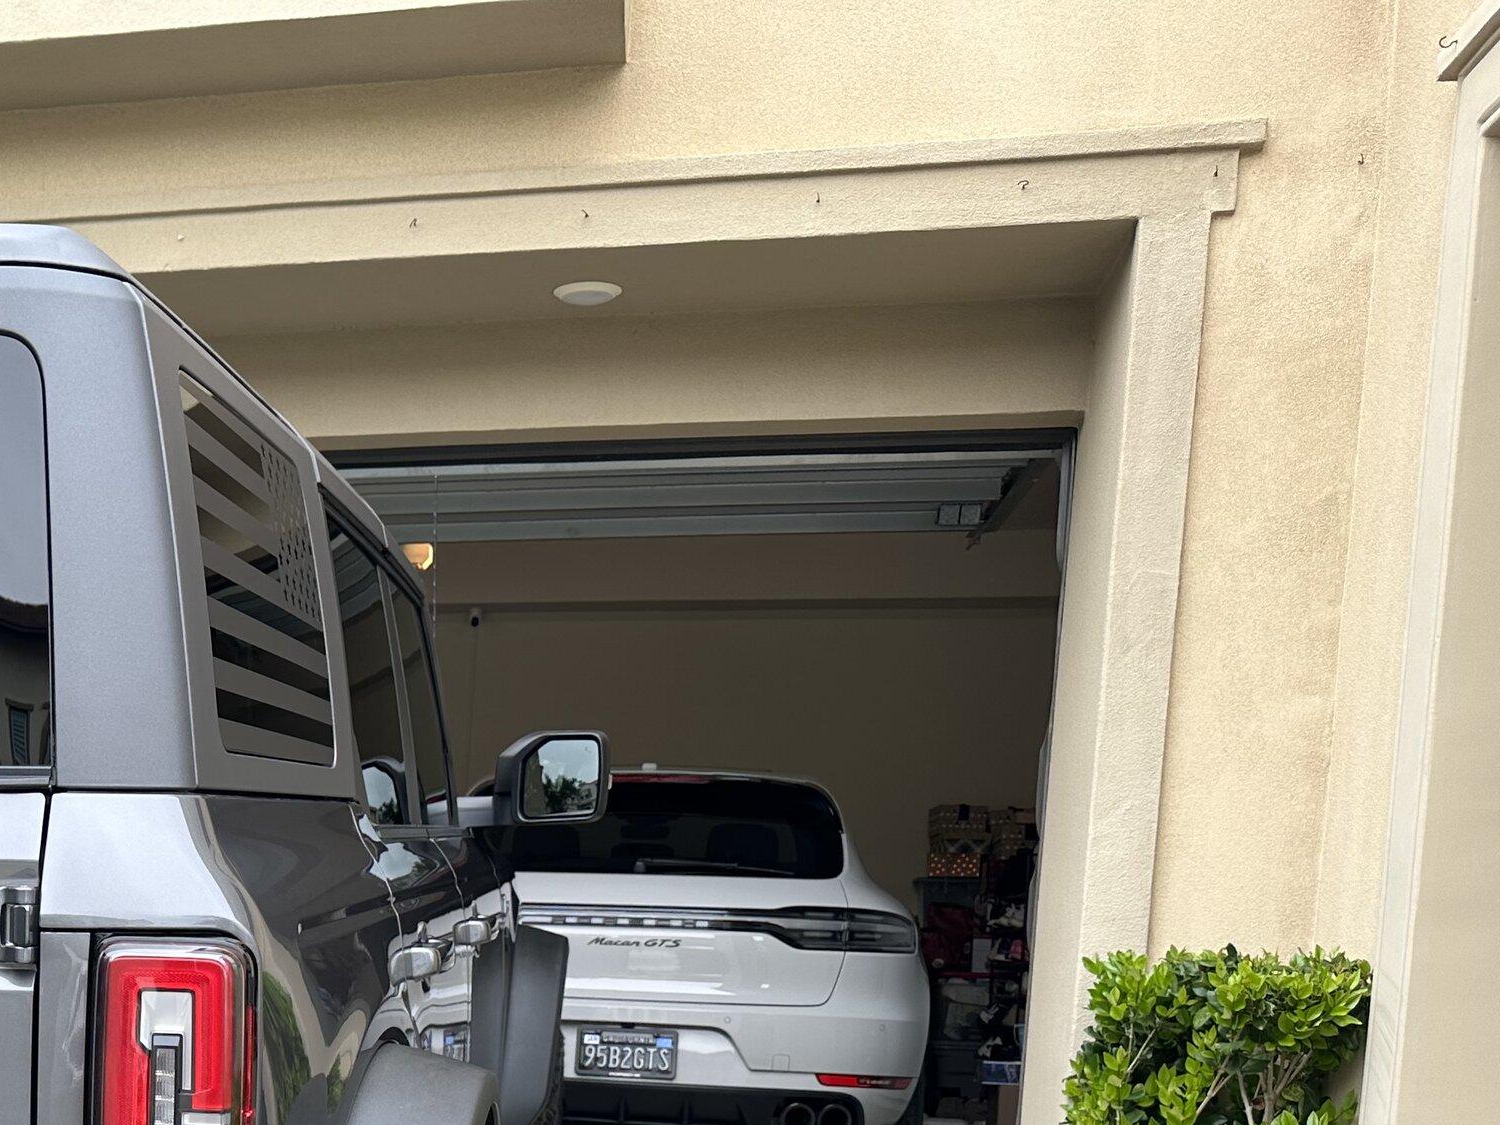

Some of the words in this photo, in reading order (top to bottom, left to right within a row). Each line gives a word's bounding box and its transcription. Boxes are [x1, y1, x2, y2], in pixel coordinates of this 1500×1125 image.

[587, 936, 640, 946] Macan
[644, 938, 682, 948] GTS
[584, 1045, 670, 1071] 95B2GTS
